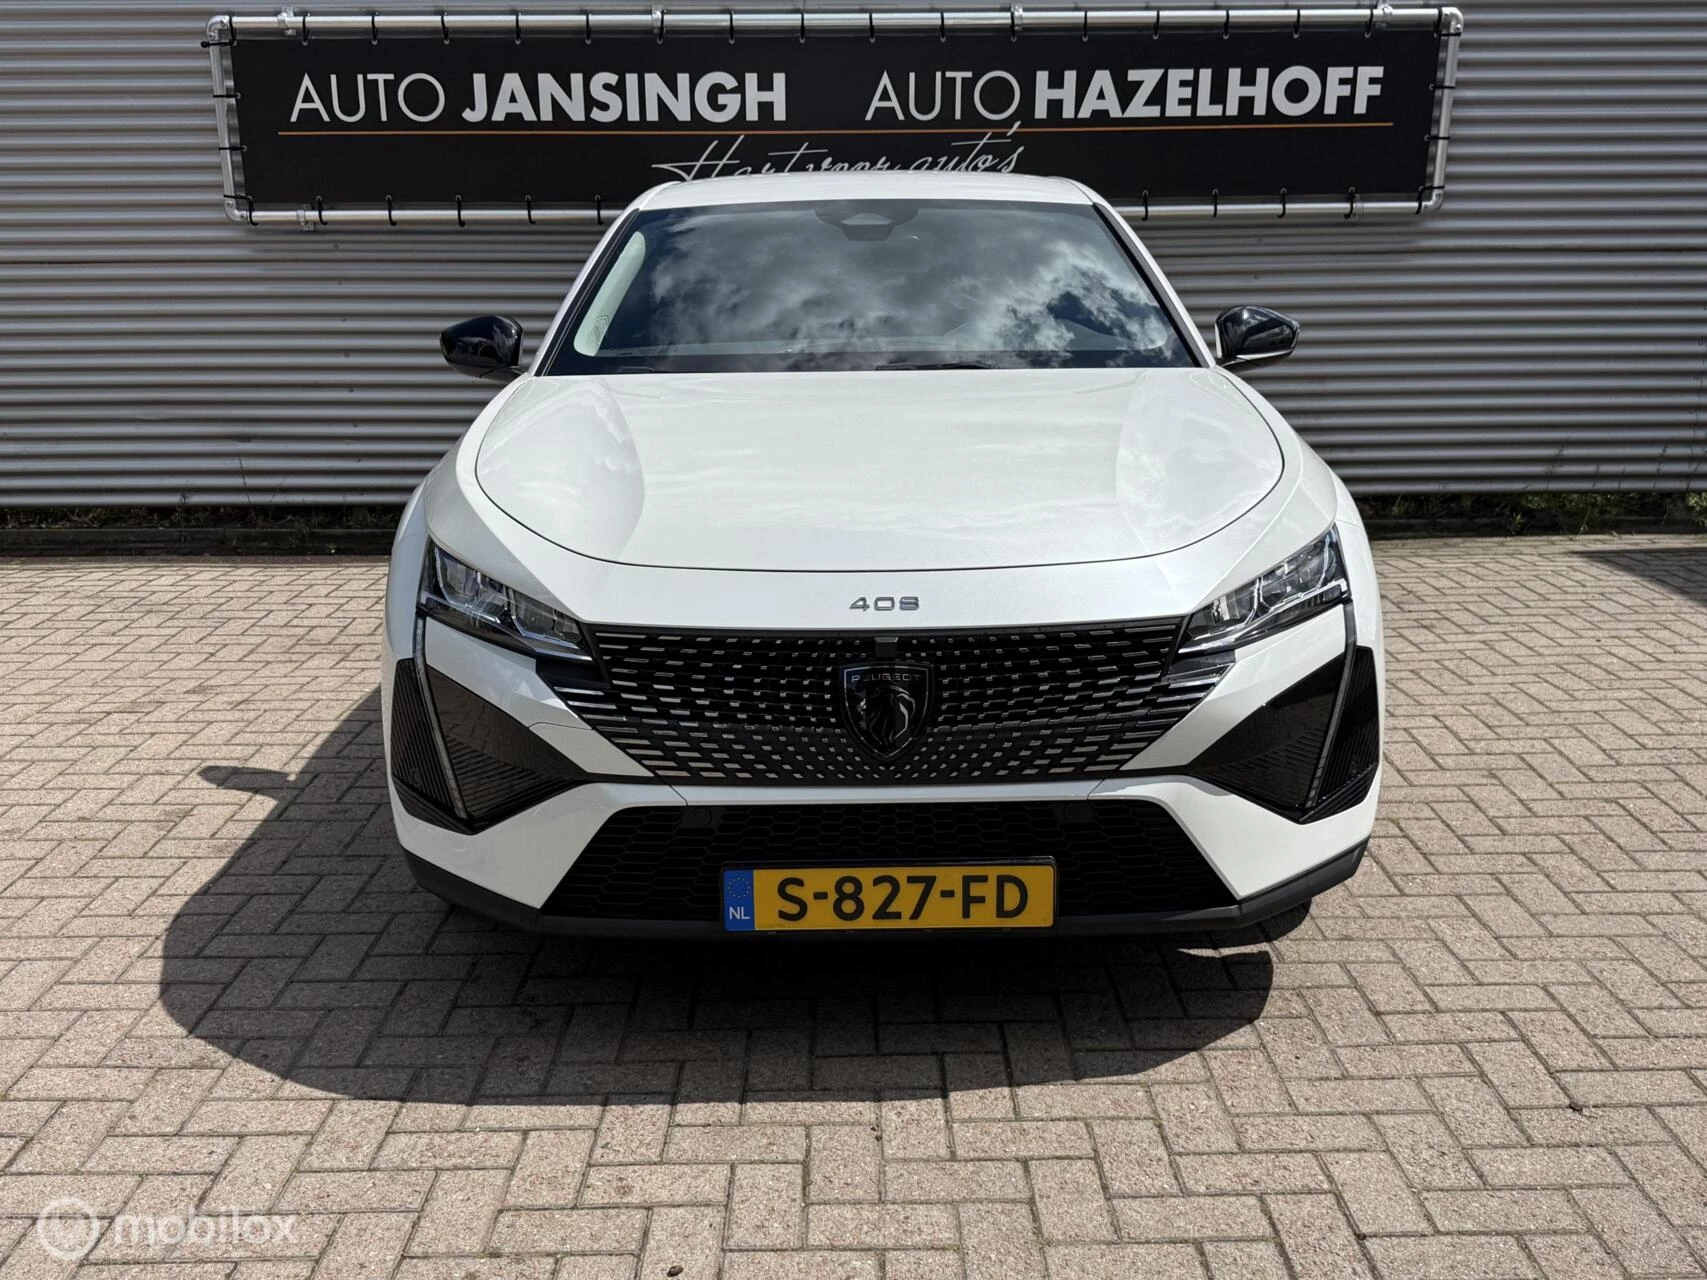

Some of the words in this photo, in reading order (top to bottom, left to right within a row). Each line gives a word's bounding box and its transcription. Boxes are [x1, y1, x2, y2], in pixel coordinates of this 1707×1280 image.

[290, 72, 445, 123] AUTO
[461, 71, 787, 123] JANSINGH
[865, 70, 1021, 122] AUTO
[1034, 65, 1384, 119] HAZELHOFF
[849, 596, 920, 612] 408
[729, 906, 750, 920] NL
[777, 874, 1029, 922] S-827-FD
